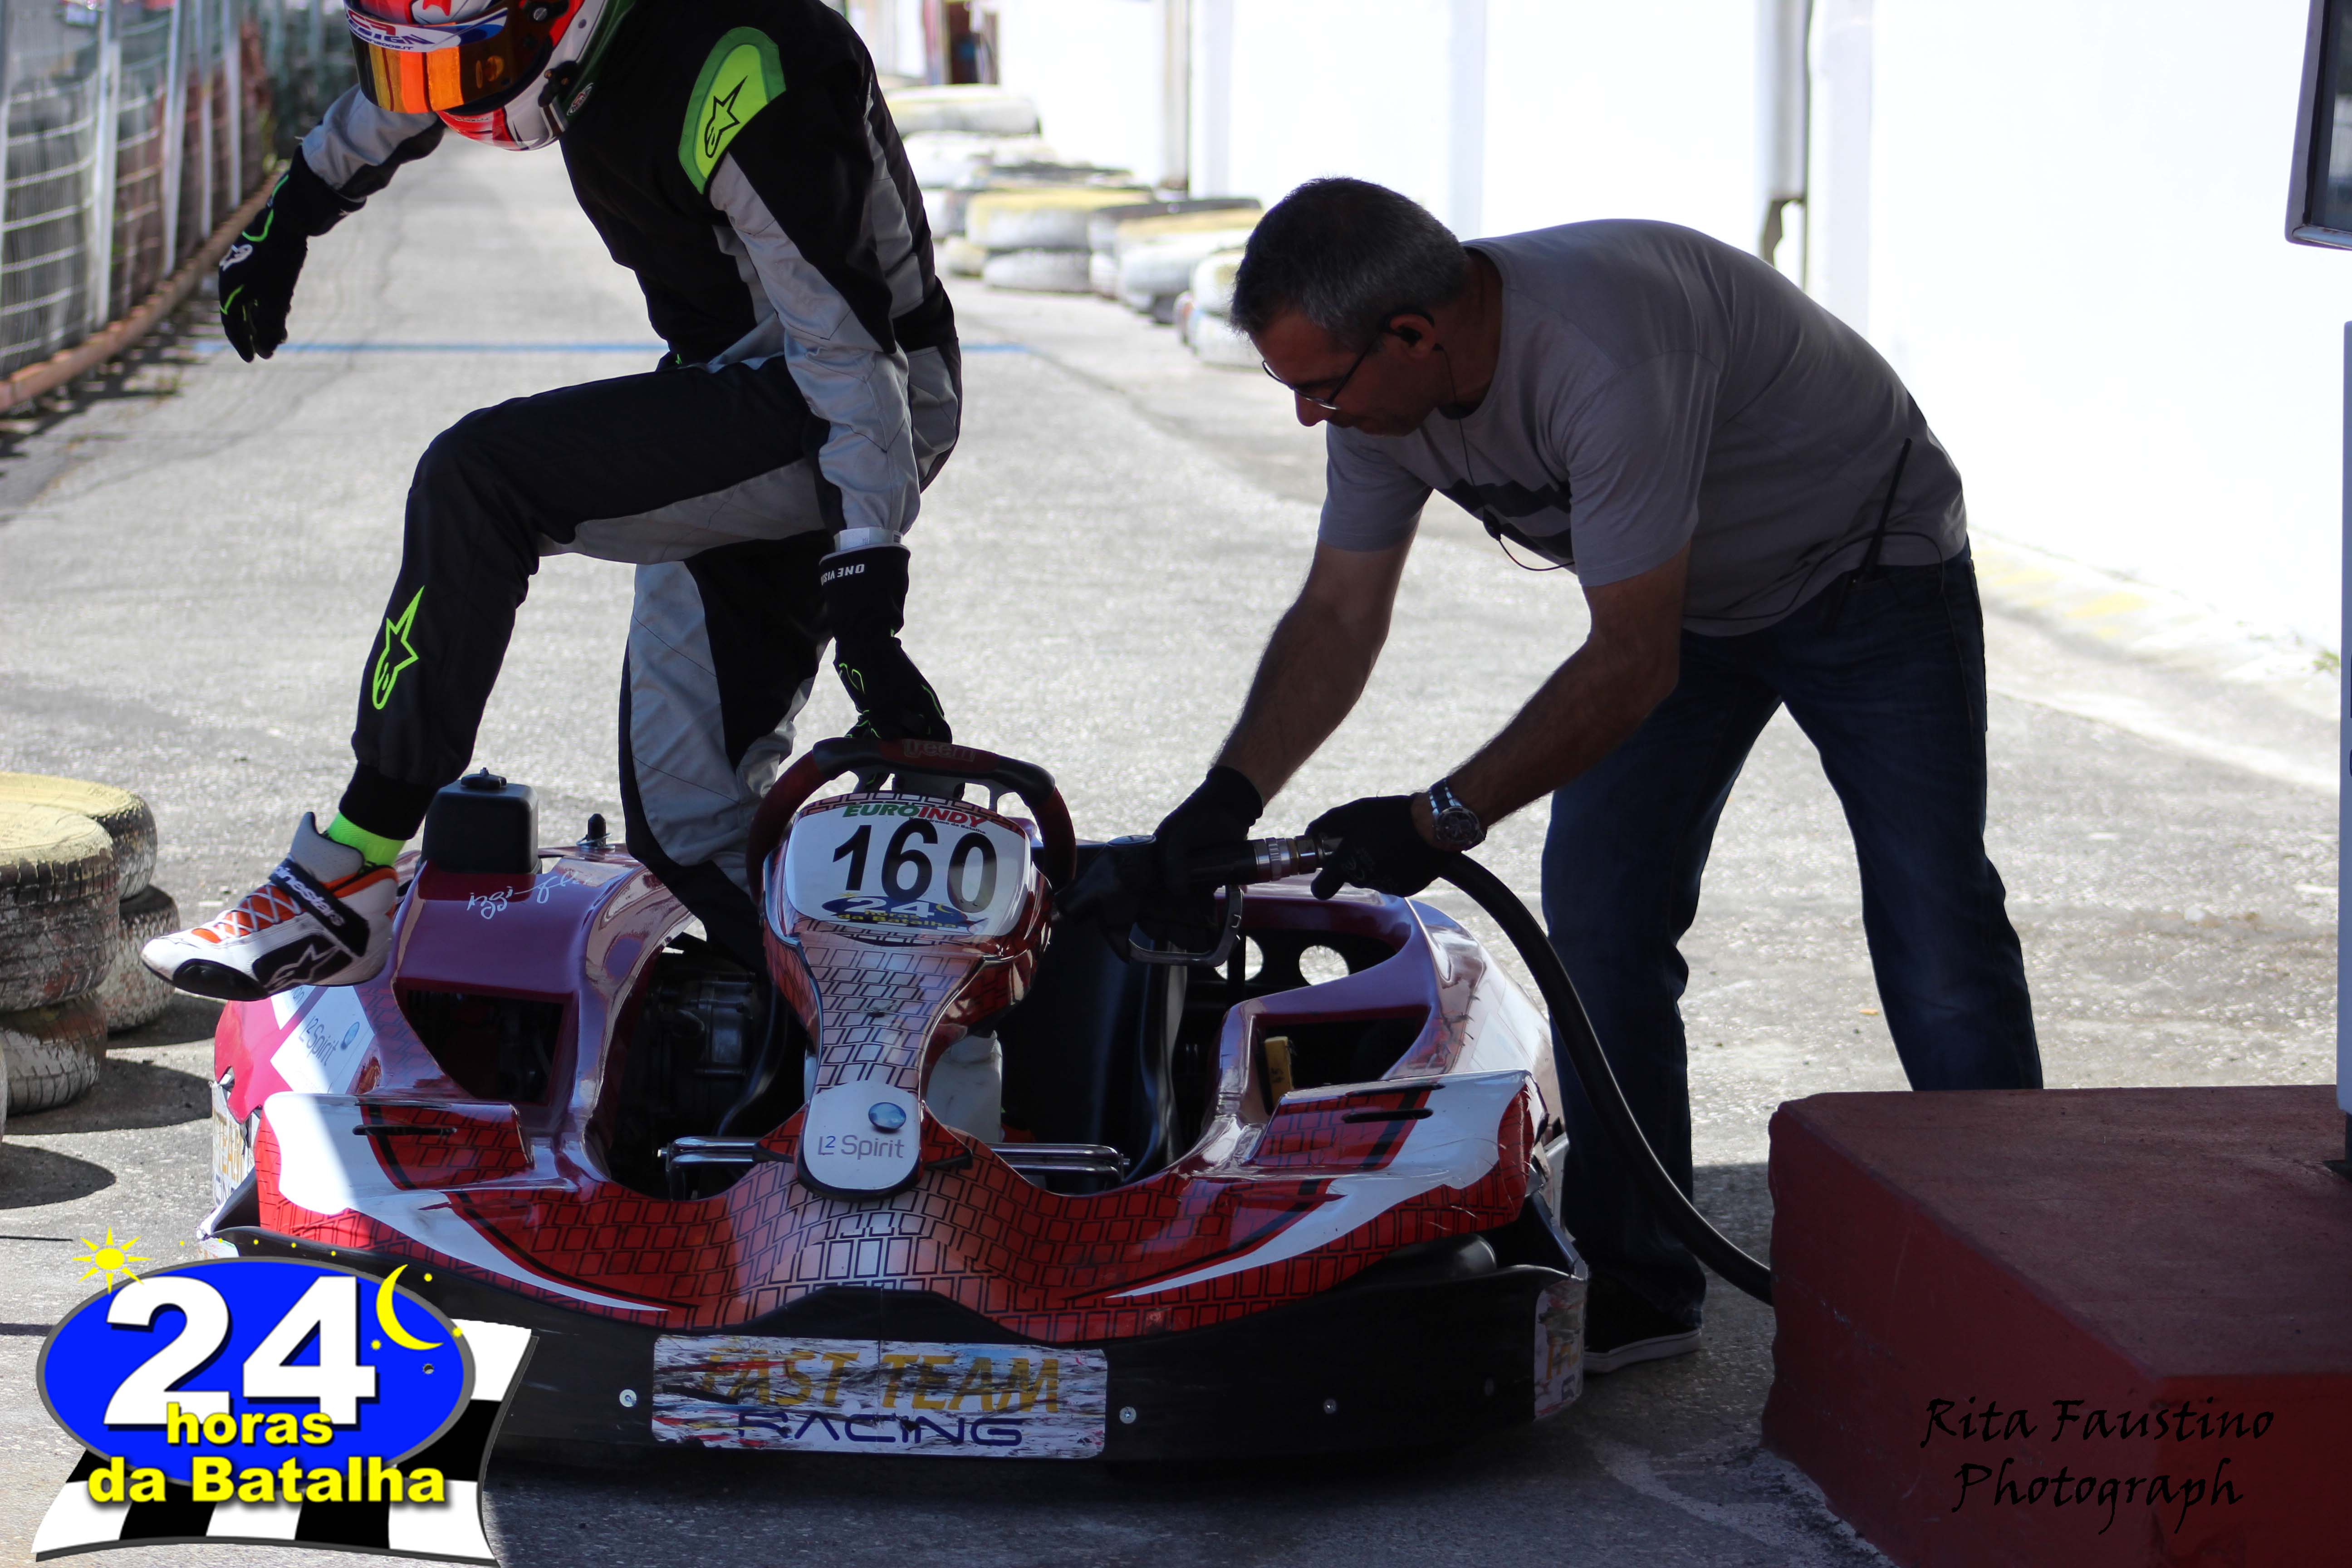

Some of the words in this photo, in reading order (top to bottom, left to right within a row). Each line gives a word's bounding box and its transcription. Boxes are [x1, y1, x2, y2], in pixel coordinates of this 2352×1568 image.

[837, 564, 865, 578] ONE
[843, 804, 987, 828] EUROINDY
[832, 818, 998, 913] 160
[844, 897, 936, 918] 24
[872, 915, 956, 929] Batalha
[306, 1024, 339, 1067] Spirit
[841, 1134, 905, 1160] Spirit
[881, 1353, 1059, 1413] TEAM
